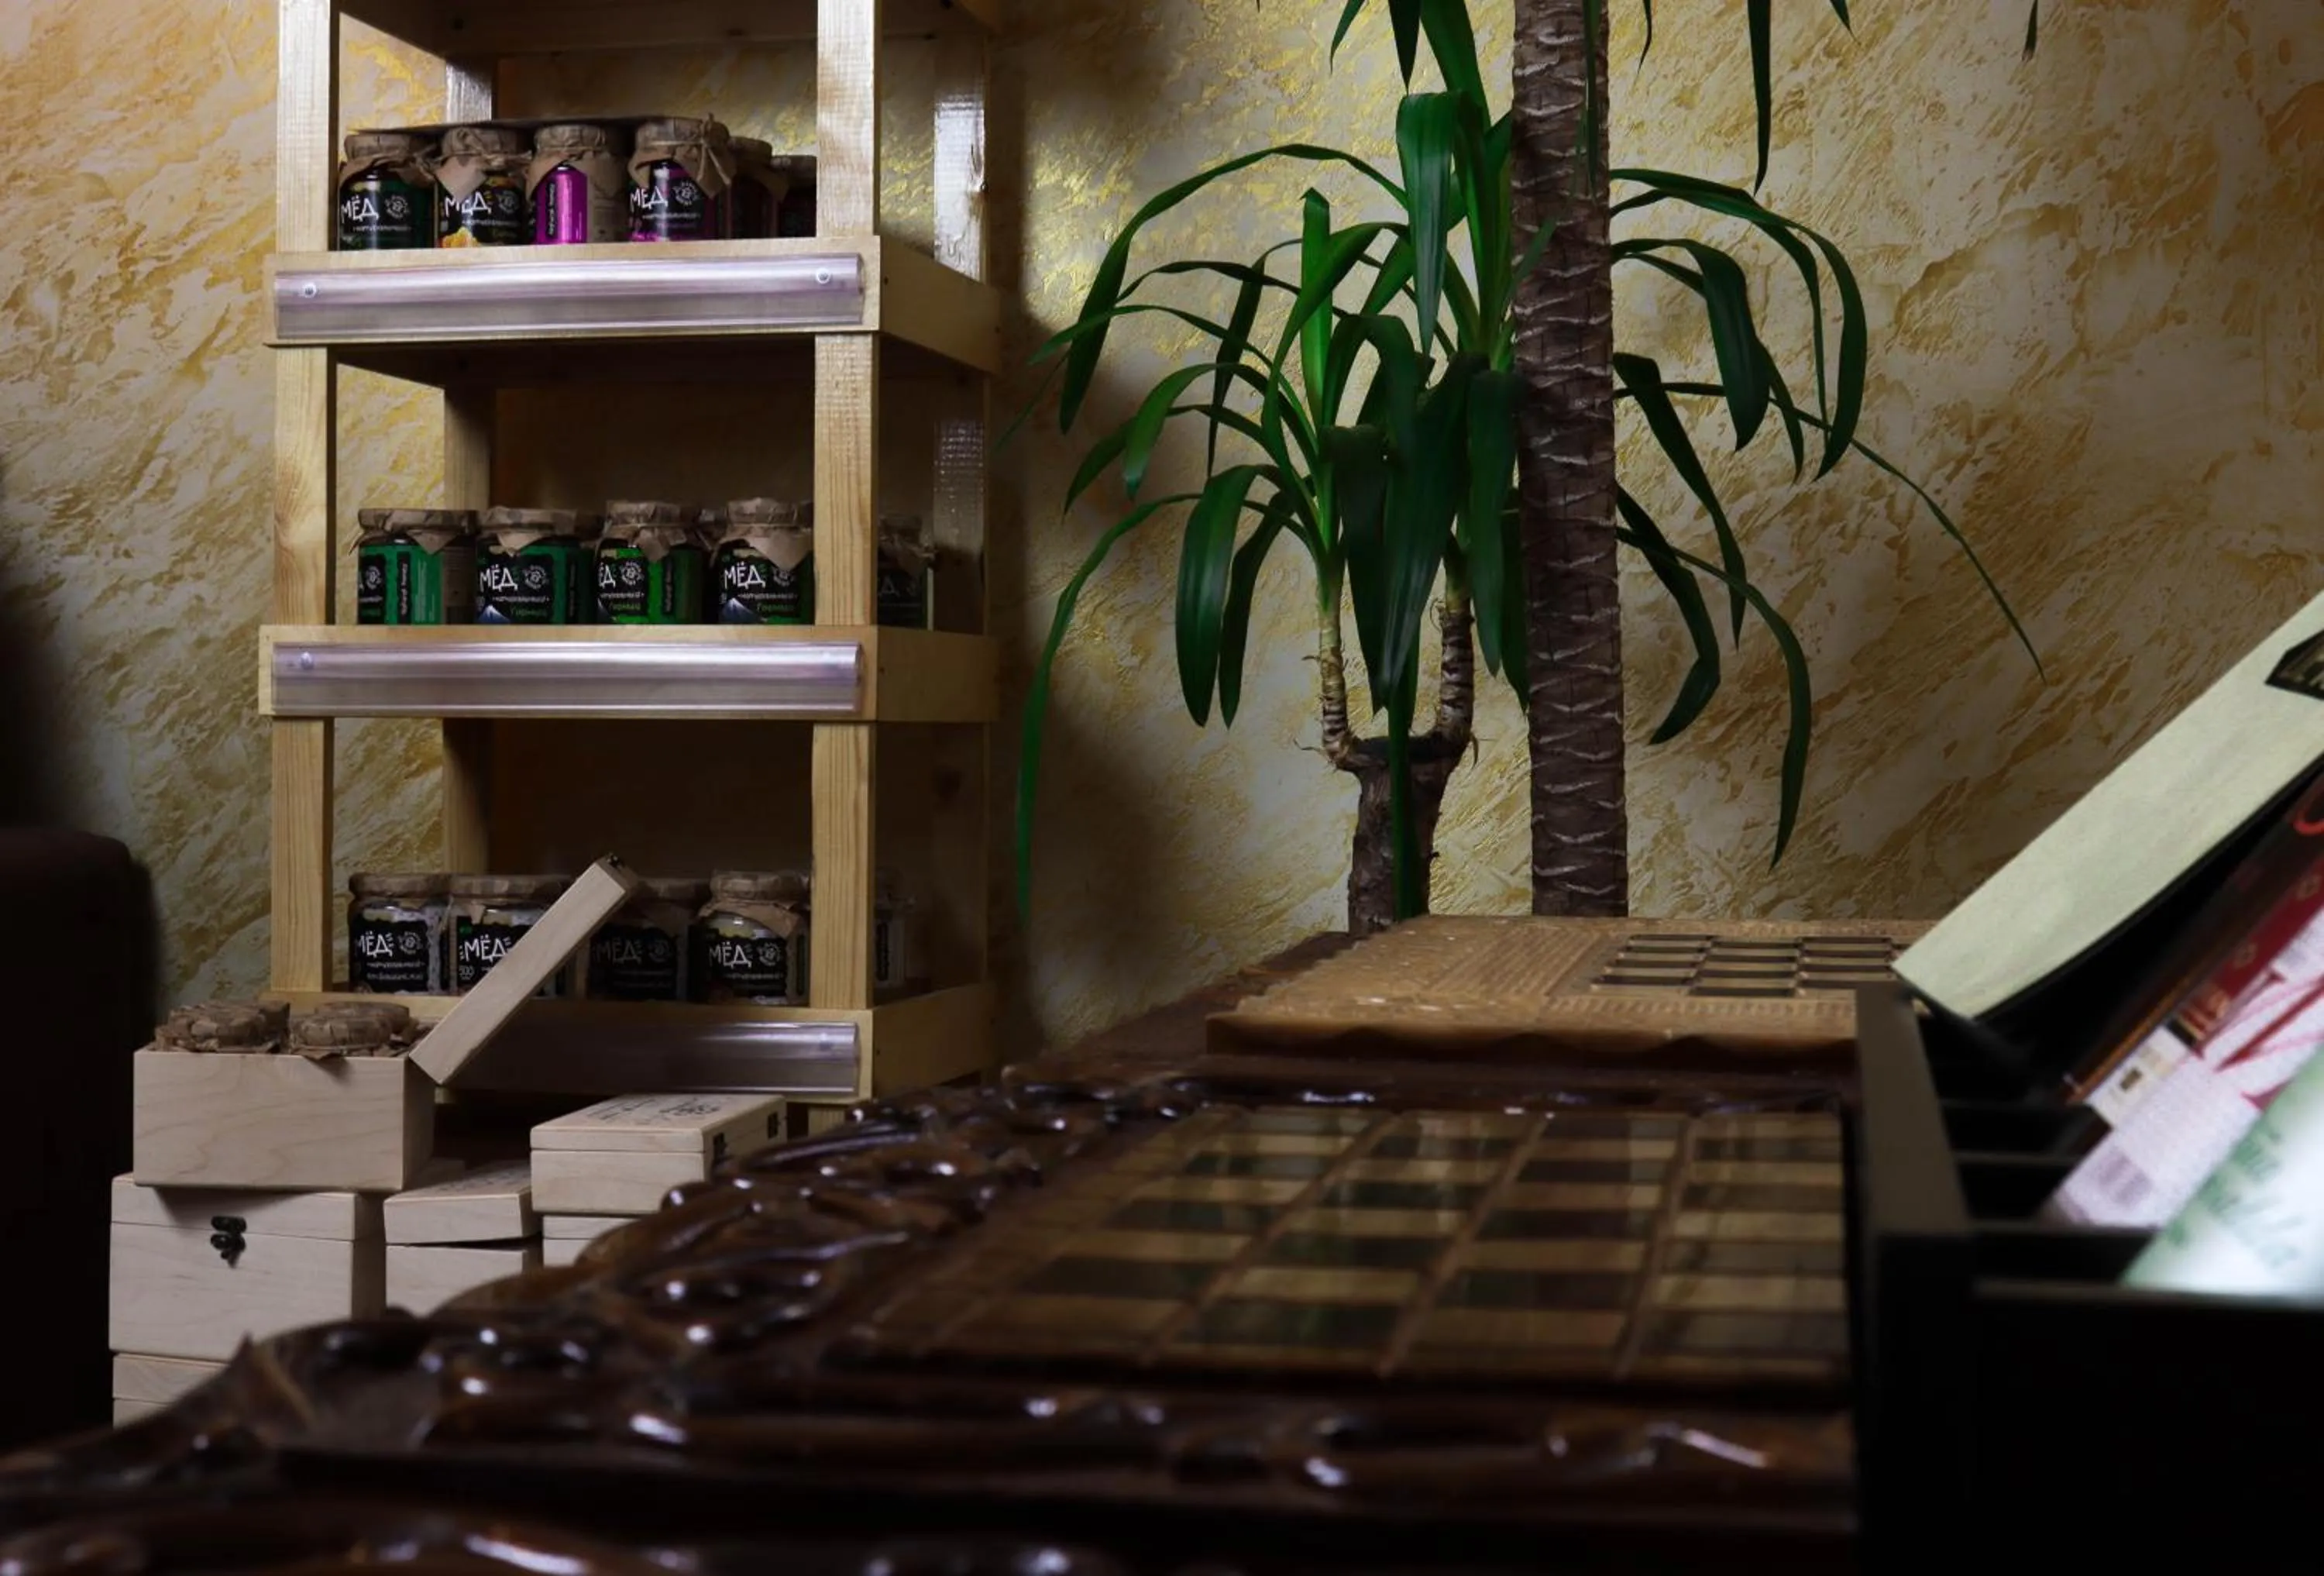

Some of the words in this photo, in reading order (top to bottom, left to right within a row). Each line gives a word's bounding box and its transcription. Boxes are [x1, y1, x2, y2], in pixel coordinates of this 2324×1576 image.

[341, 194, 379, 224] МЁД
[479, 563, 518, 594] МЁД
[598, 562, 616, 590] ЁД
[724, 561, 766, 590] МЁД
[464, 934, 507, 963] МЁД
[709, 941, 752, 969] МЁД
